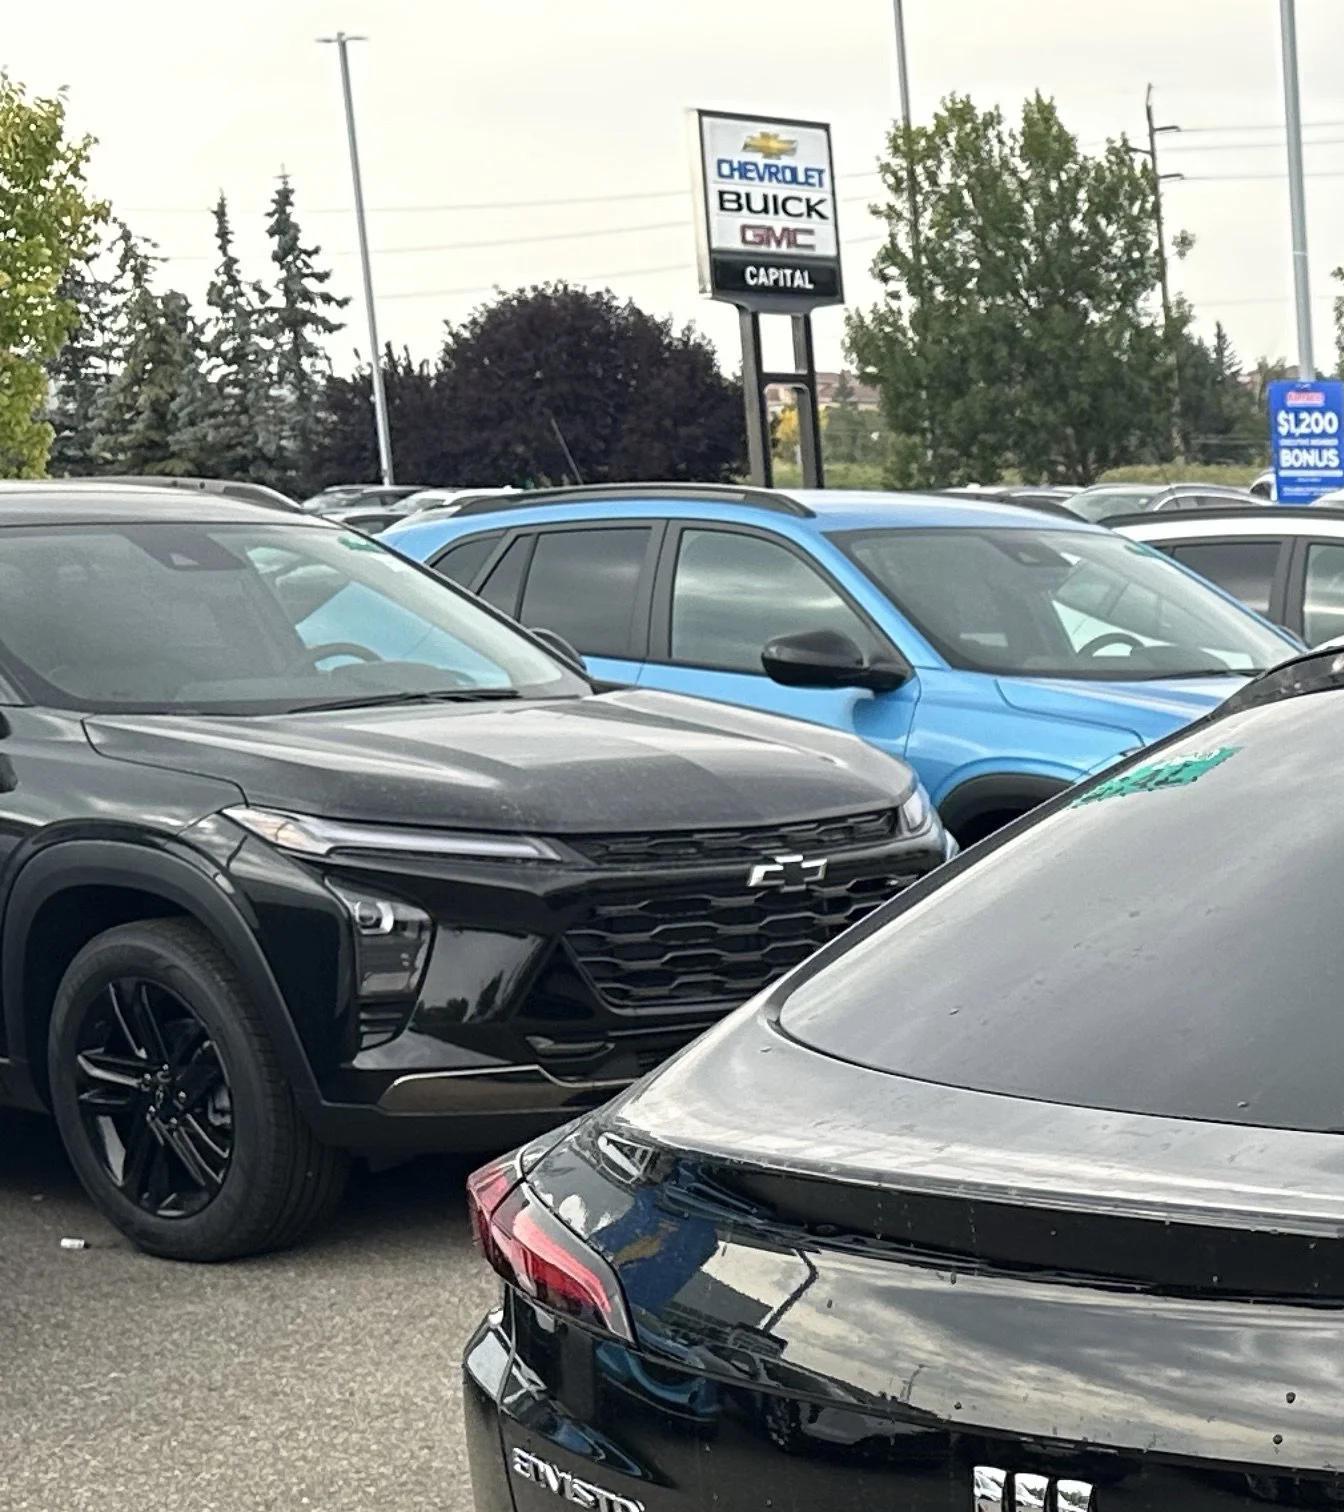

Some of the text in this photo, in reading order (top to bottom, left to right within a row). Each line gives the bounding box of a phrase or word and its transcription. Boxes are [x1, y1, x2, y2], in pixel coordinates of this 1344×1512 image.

[717, 158, 826, 188] CHEVROLET
[717, 189, 829, 221] BUICK
[740, 223, 815, 250] GMC
[744, 266, 814, 290] CAPITAL
[1277, 409, 1339, 437] $1,200
[1280, 447, 1341, 469] BONUS
